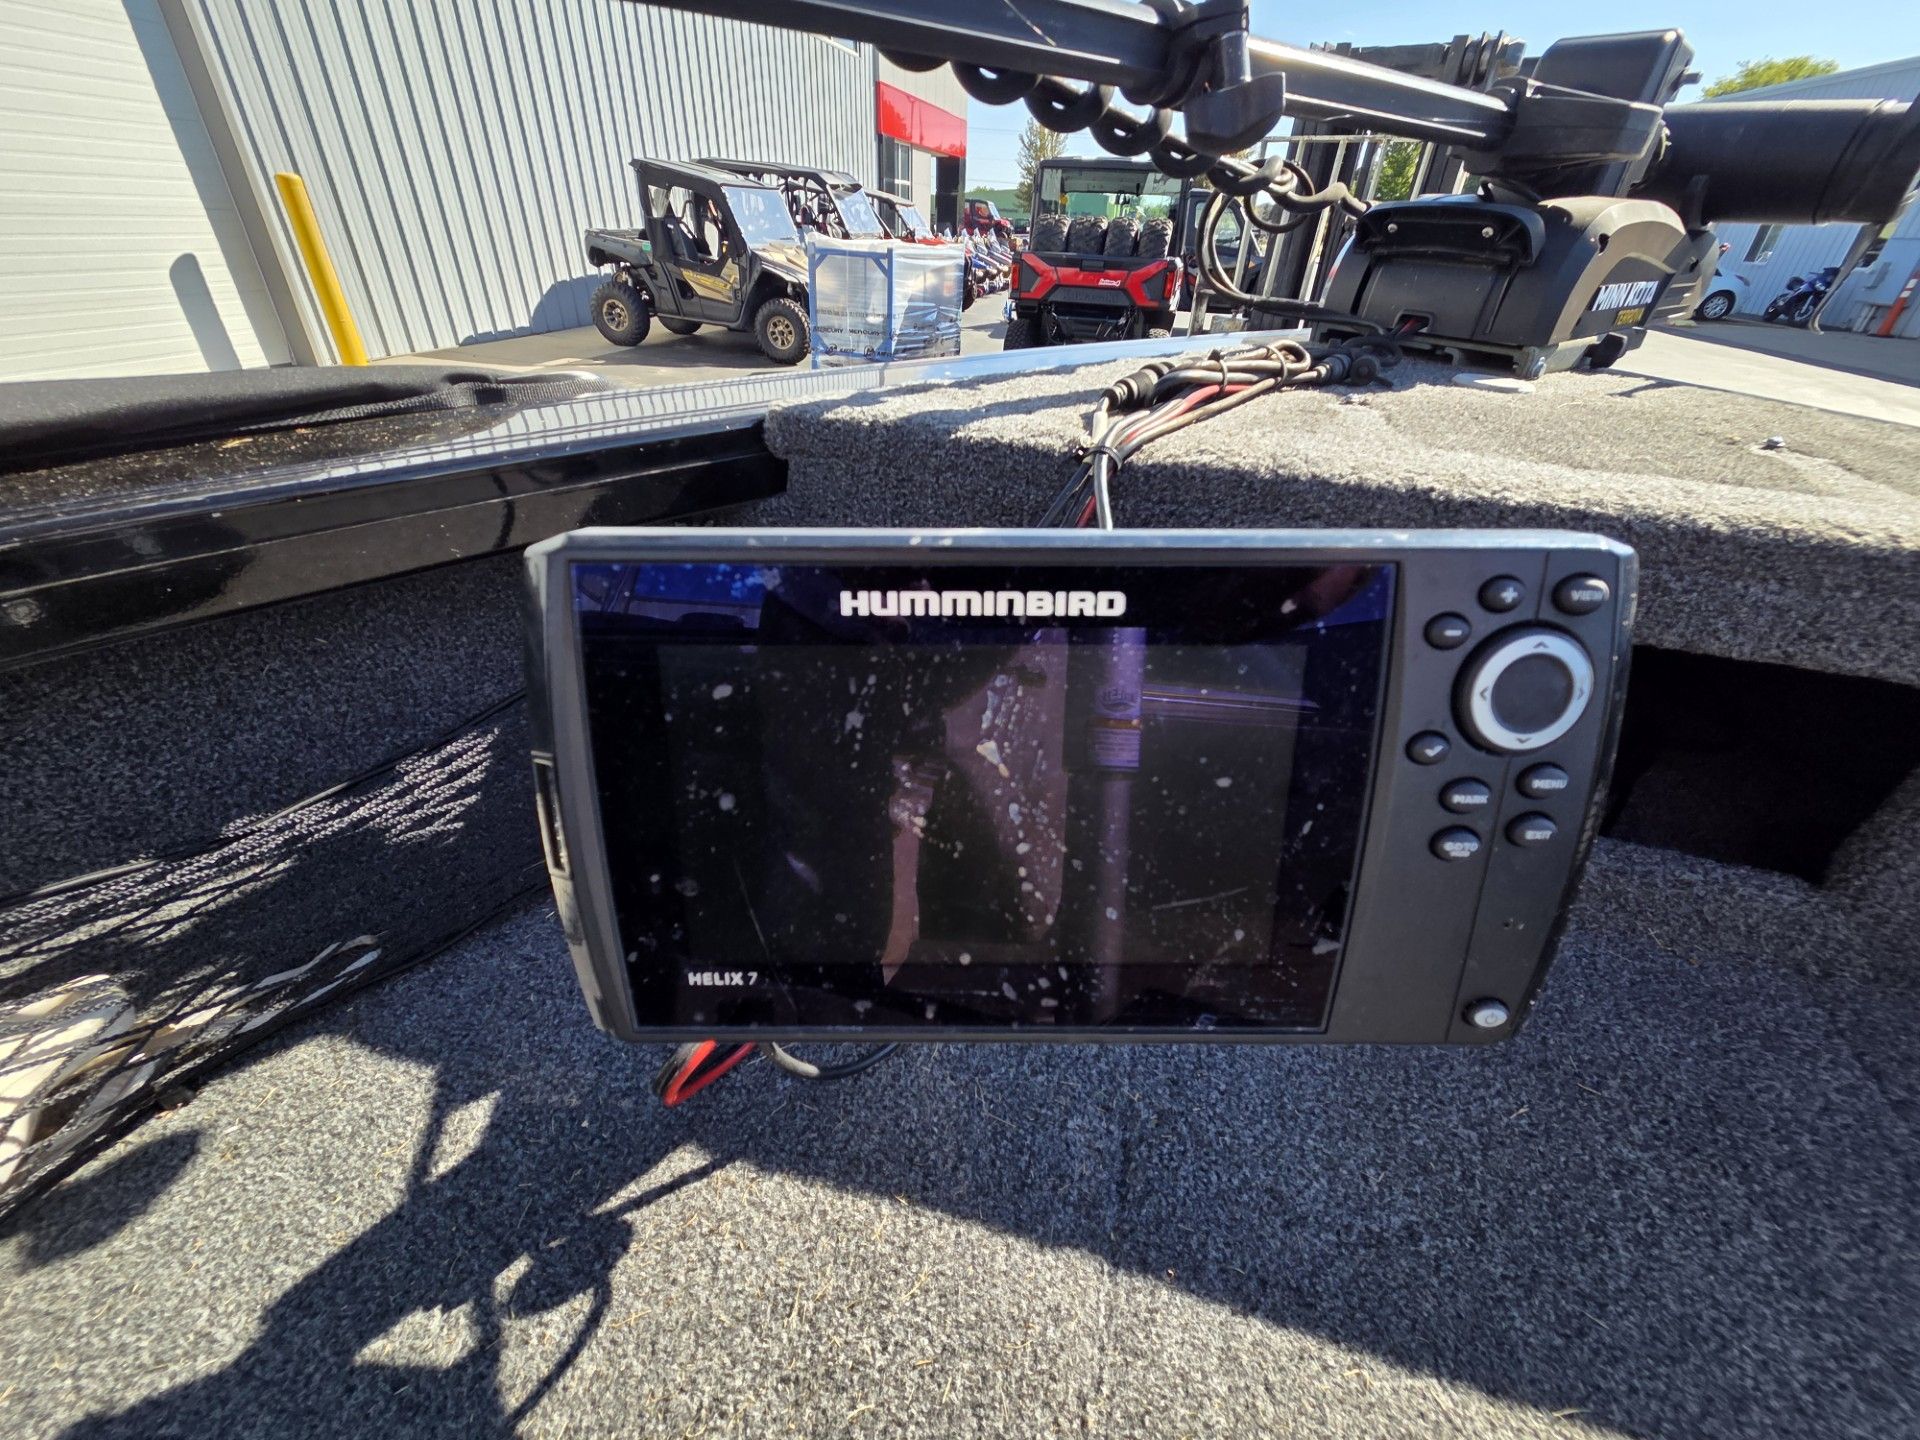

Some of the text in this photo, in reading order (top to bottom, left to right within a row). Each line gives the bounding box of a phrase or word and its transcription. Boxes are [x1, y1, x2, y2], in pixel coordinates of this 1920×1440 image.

[1592, 280, 1659, 311] MINN KOTA
[1571, 589, 1604, 601] VIEW
[840, 590, 1127, 617] HUMMINBIRD
[1531, 778, 1568, 789] MENU
[1452, 794, 1489, 804] MARK
[1524, 830, 1552, 840] EXIT
[688, 971, 758, 986] HELIX 7
